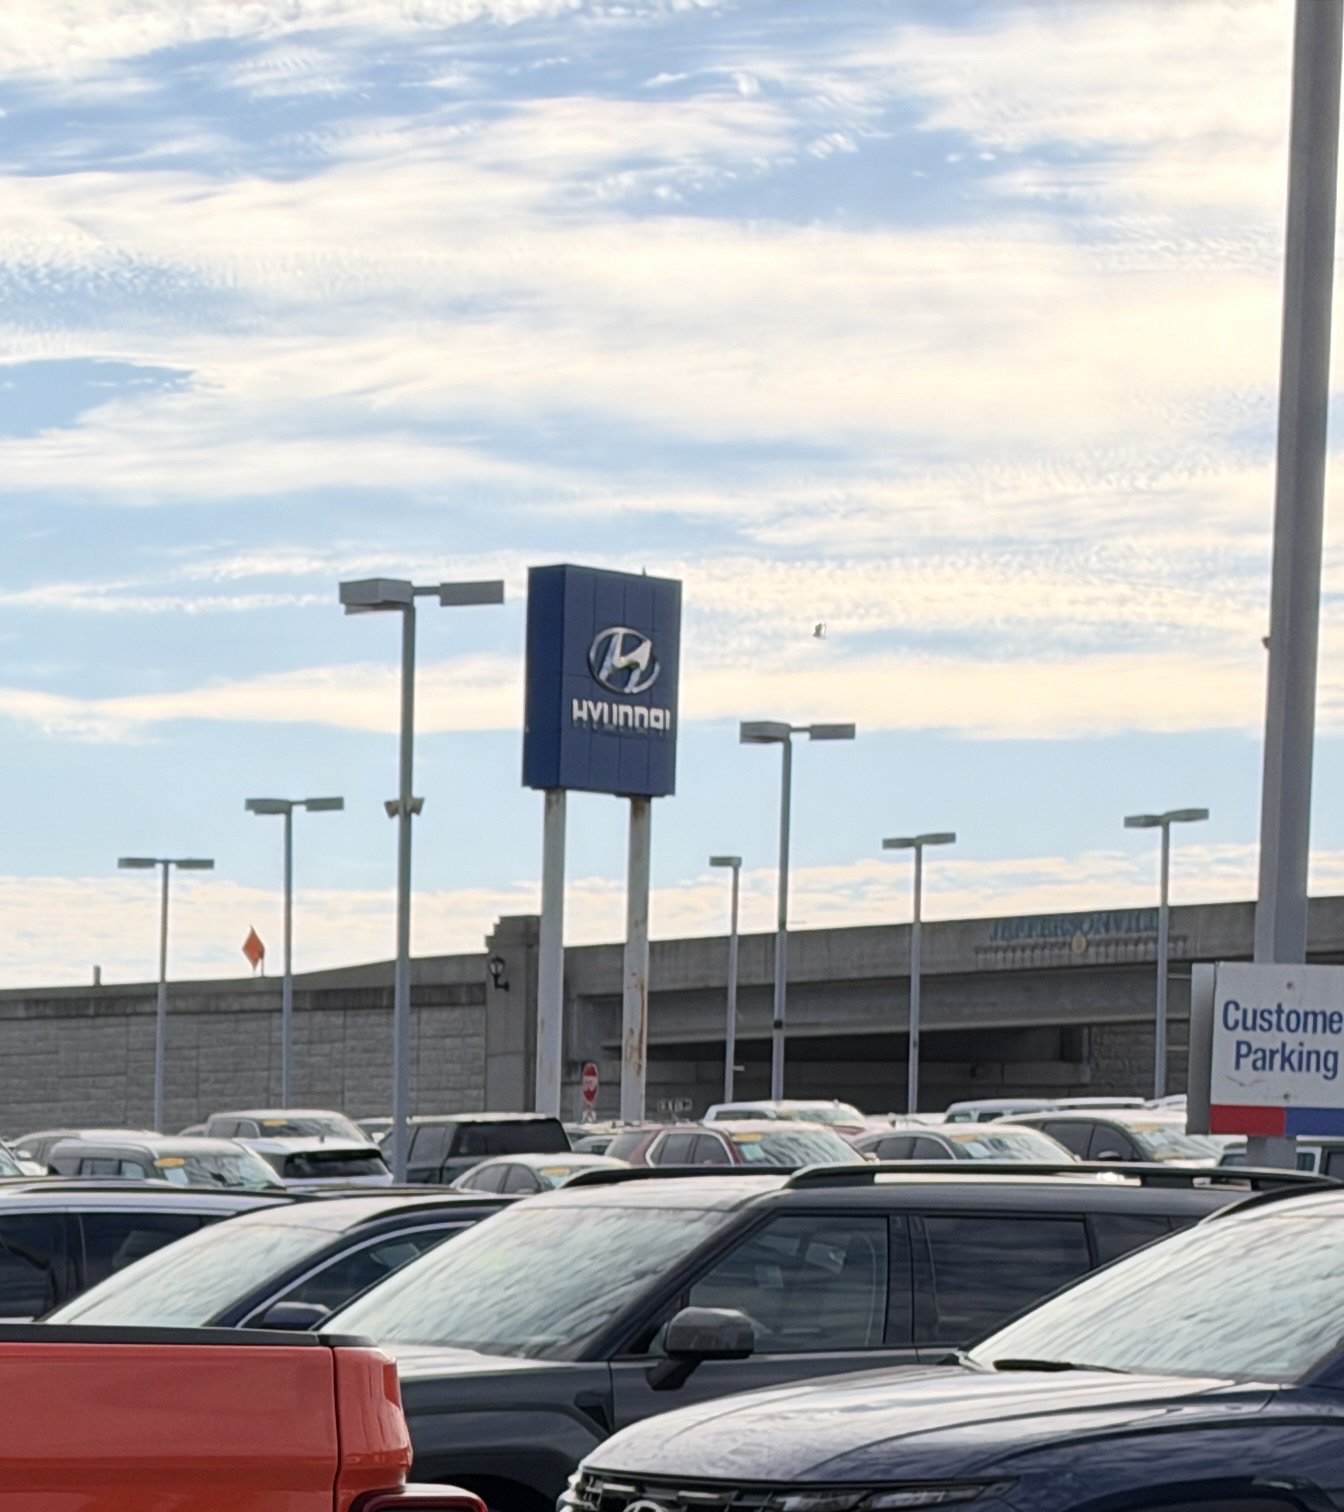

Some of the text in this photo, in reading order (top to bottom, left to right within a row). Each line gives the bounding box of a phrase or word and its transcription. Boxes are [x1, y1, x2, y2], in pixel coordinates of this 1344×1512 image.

[571, 698, 671, 730] HYUNDAI
[1222, 999, 1344, 1034] Custome
[1234, 1040, 1339, 1080] Parking
